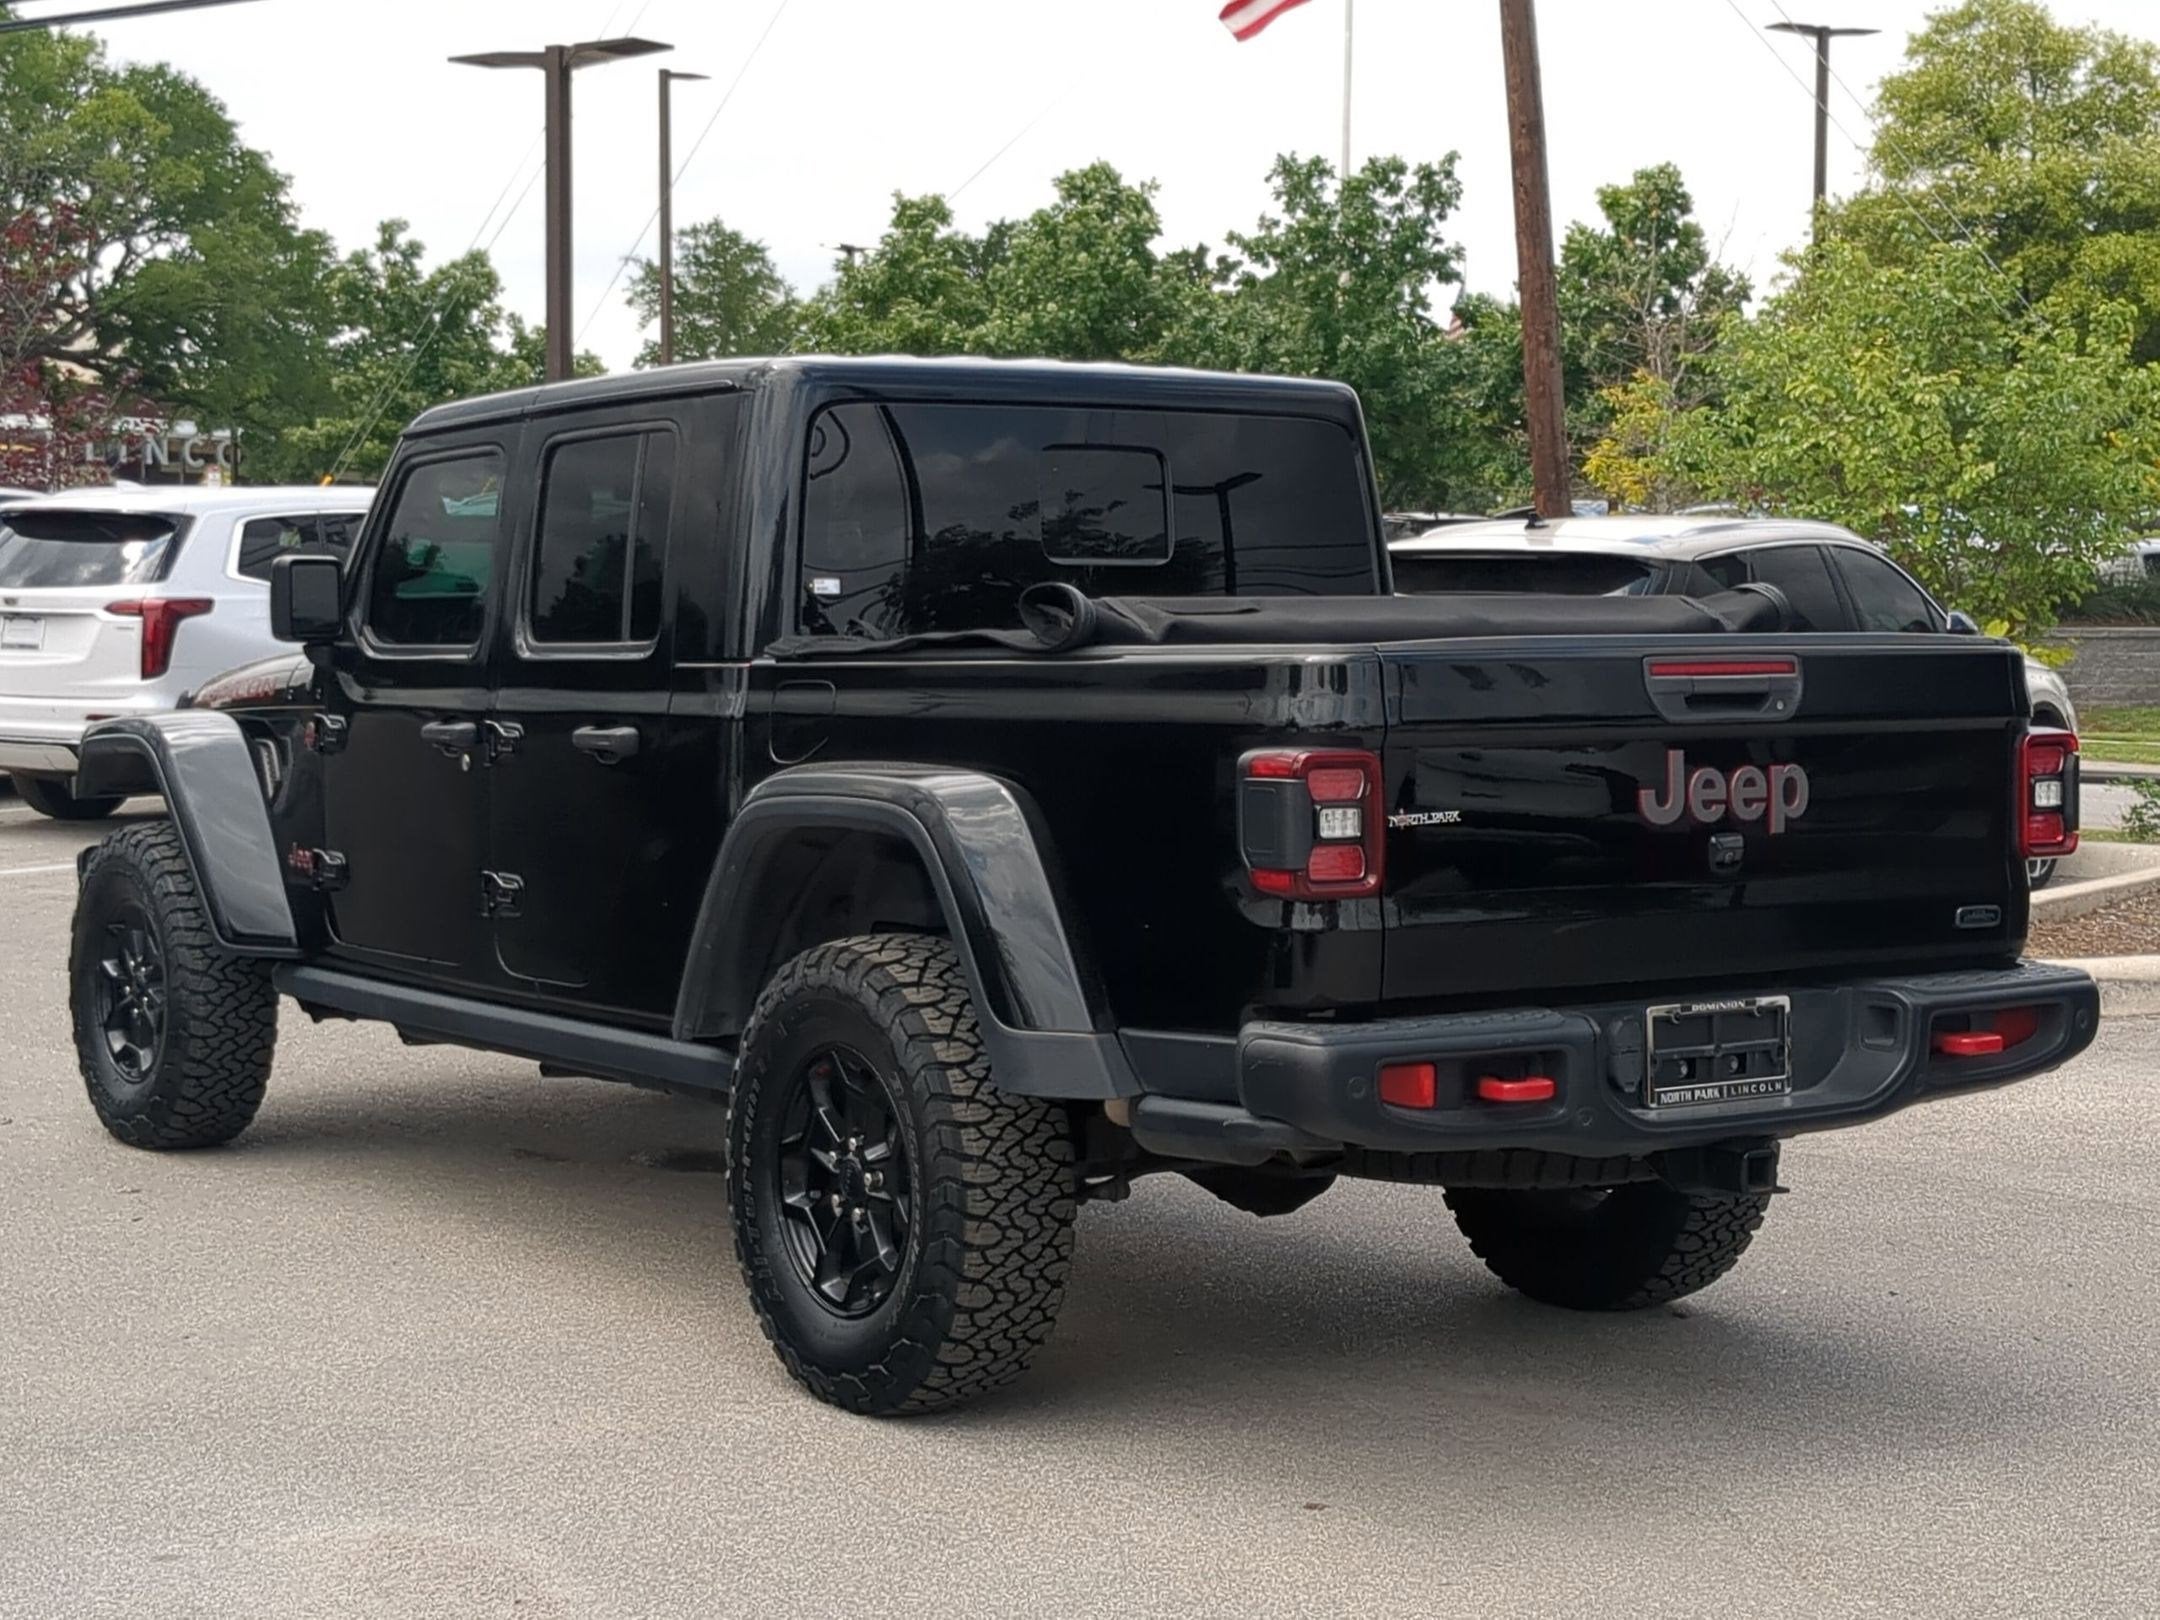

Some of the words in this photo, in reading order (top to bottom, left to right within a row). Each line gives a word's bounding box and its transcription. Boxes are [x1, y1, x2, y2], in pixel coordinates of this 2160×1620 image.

[1638, 749, 1810, 834] Jeep
[1430, 811, 1462, 824] PARK
[1691, 1000, 1746, 1012] DOMINION
[1660, 1089, 1692, 1104] NORTH
[1694, 1087, 1720, 1100] PARK
[1731, 1081, 1783, 1096] LINCOLN
